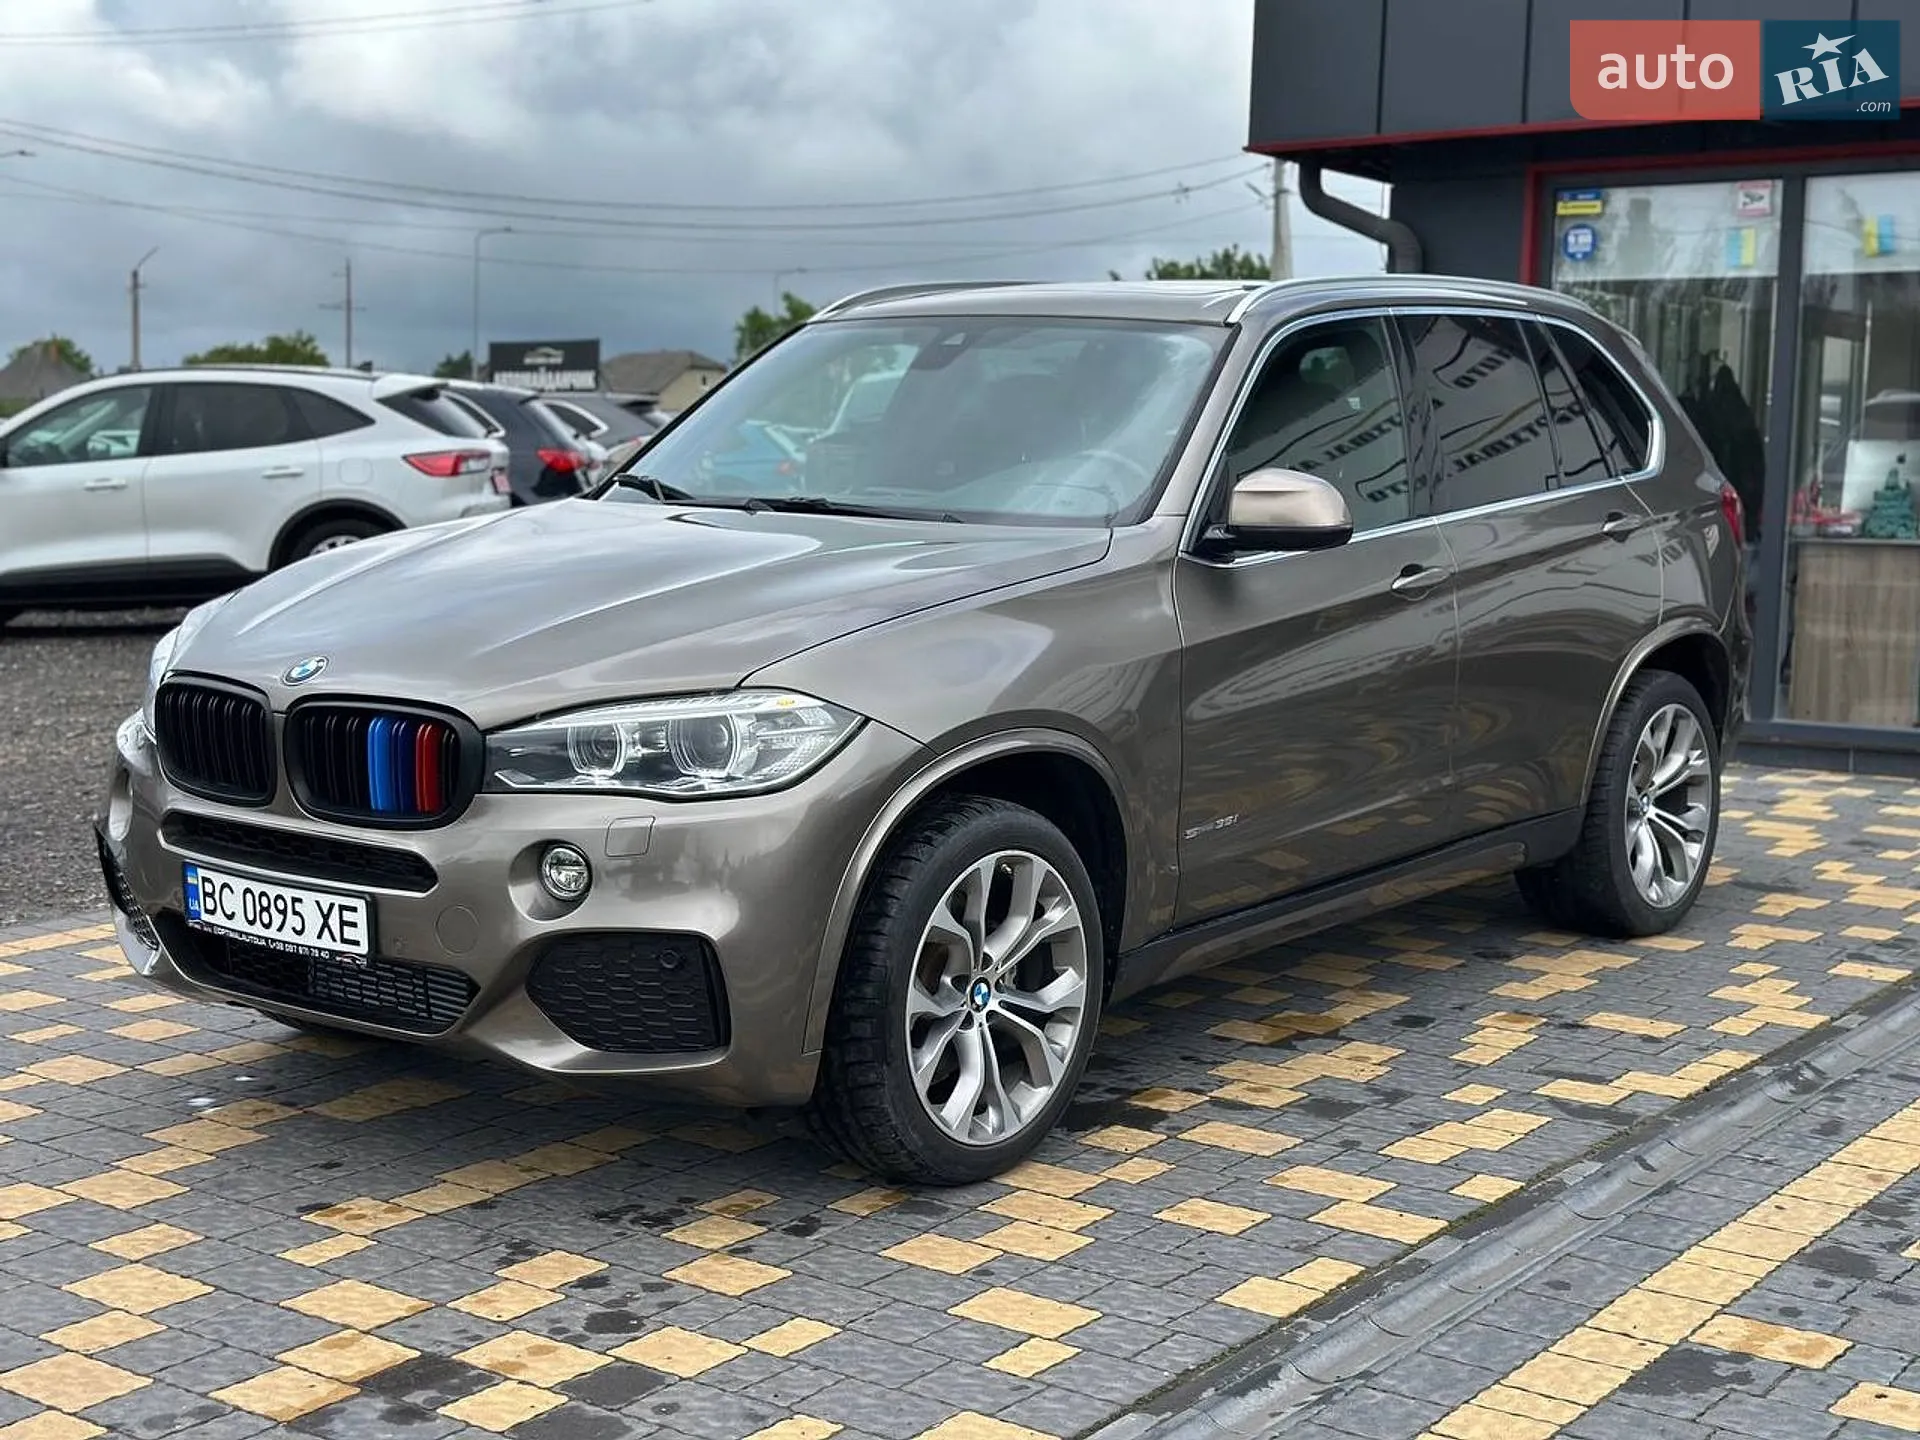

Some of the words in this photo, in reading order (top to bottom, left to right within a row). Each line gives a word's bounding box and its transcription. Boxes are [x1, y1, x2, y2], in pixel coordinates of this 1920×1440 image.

[202, 877, 236, 920] BC
[242, 887, 306, 936] 0895
[315, 900, 361, 947] XE
